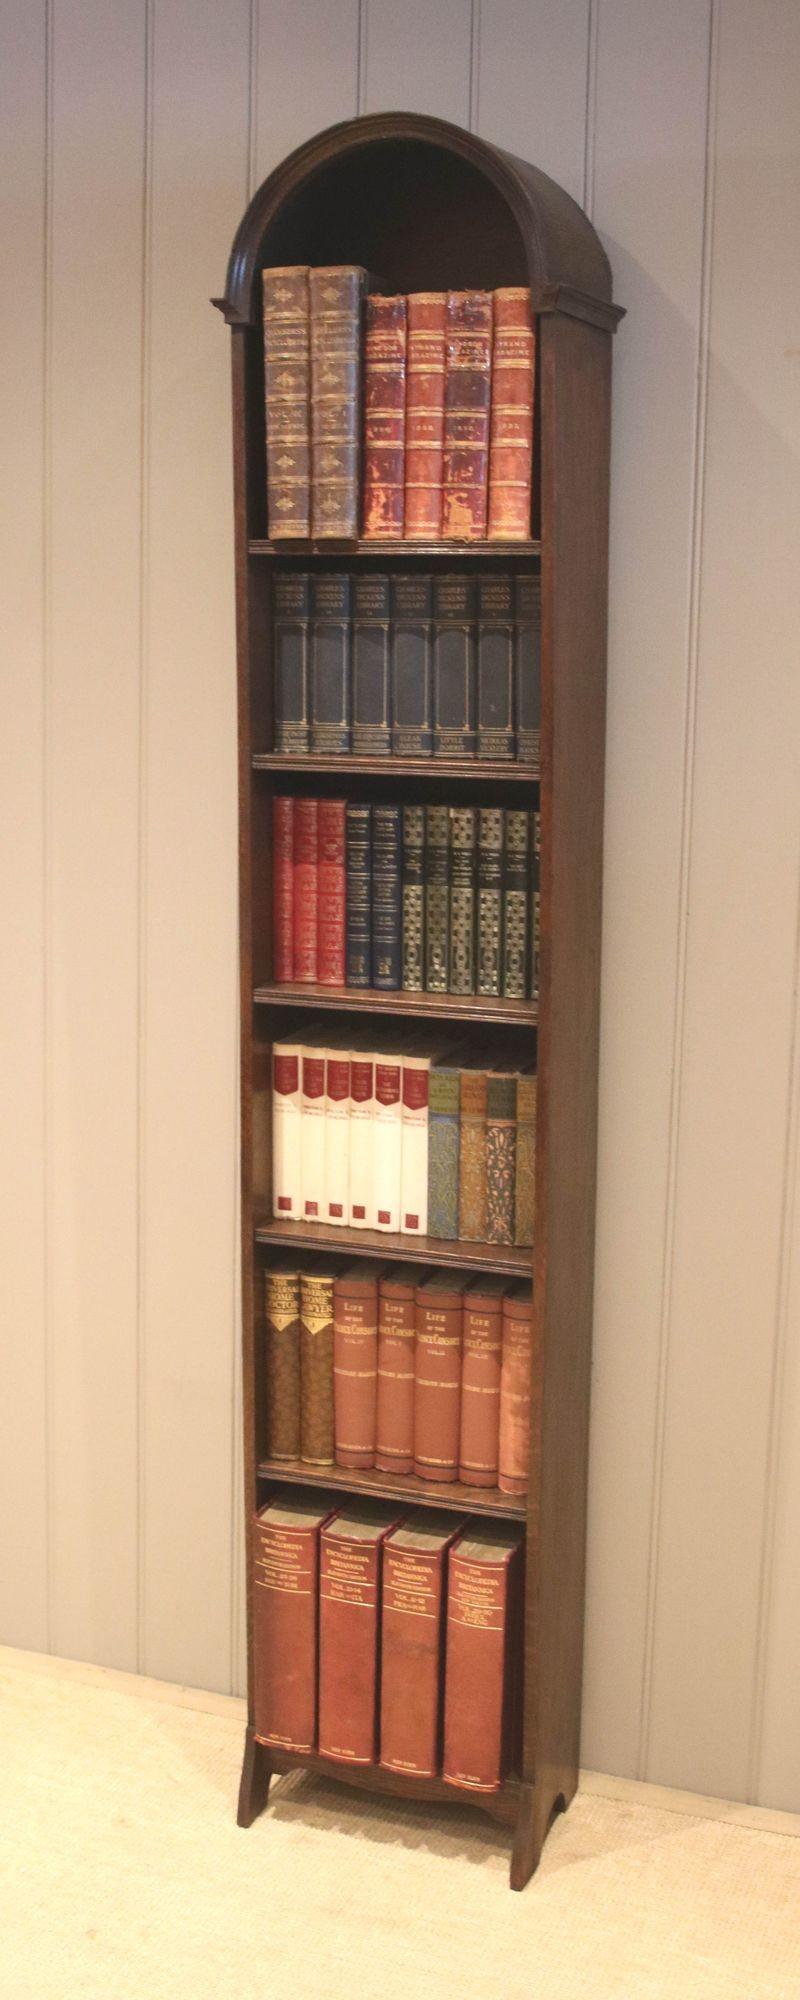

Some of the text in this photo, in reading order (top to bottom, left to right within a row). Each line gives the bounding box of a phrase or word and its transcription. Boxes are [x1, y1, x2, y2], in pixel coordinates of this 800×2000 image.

[344, 1303, 364, 1312] LIFE
[385, 1303, 404, 1313] LIFE
[426, 1312, 446, 1322] LIFE
[470, 1316, 490, 1327] LIFE
